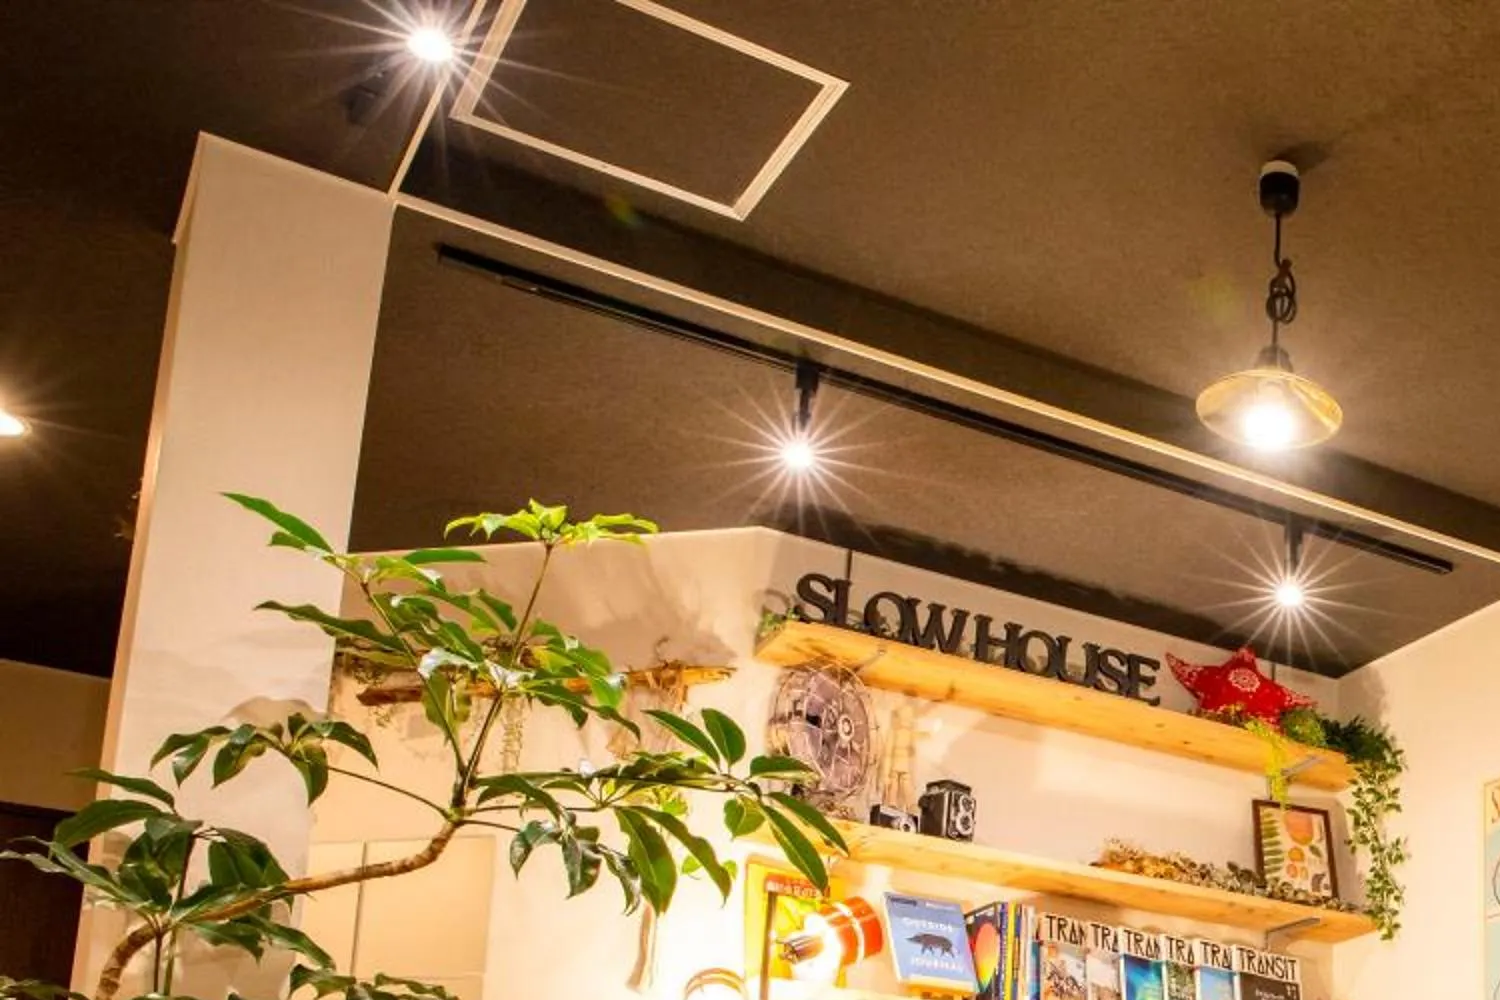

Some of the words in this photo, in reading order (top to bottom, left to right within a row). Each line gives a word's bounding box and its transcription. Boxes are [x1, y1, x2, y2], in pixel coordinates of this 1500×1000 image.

[795, 573, 970, 654] SLOW
[973, 613, 1161, 706] HOUSE
[1236, 947, 1297, 981] TRANSIT
